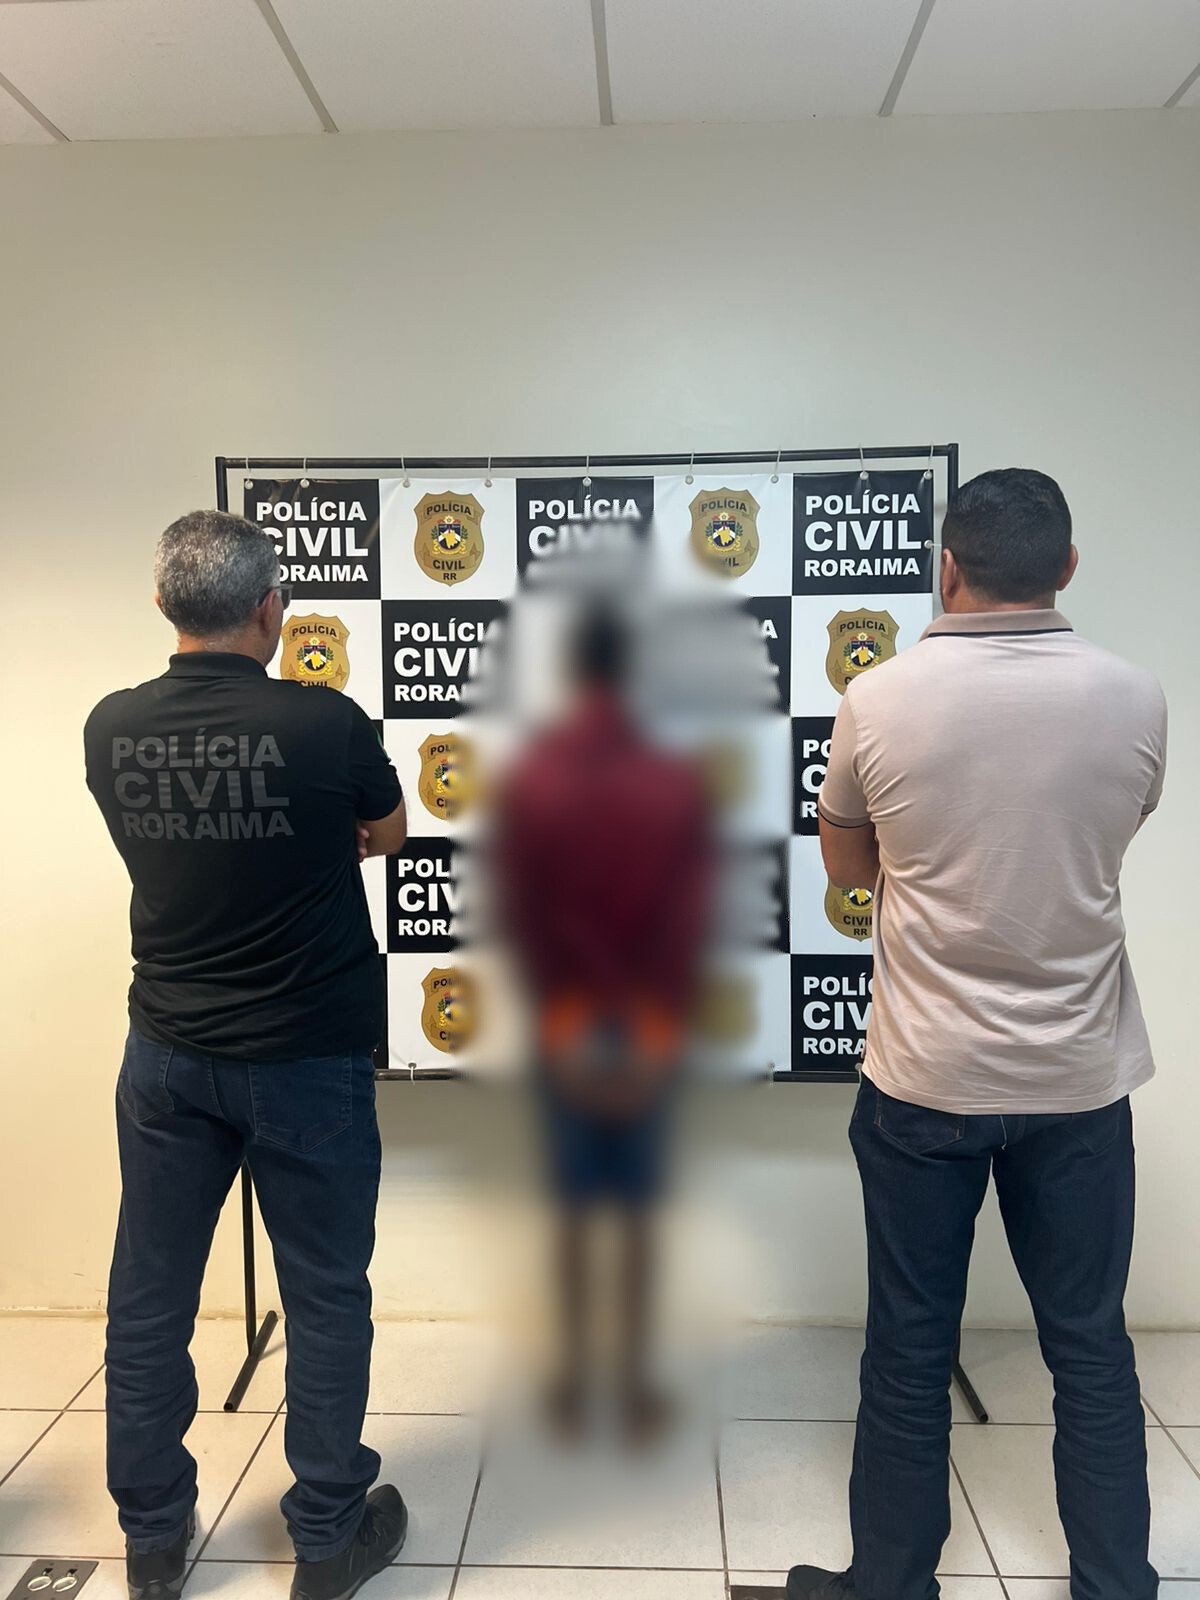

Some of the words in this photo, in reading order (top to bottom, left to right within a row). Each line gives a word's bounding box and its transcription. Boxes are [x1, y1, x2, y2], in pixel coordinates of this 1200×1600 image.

[256, 497, 367, 521] POLÍCIA
[426, 502, 472, 515] POLÍCIA
[529, 494, 641, 520] POLÍCIA
[701, 499, 747, 513] POLÍCIA
[806, 490, 920, 515] POLÍCIA
[805, 520, 921, 551] CIVIL
[280, 564, 368, 582] ORAIMA
[432, 559, 466, 571] CIVIL
[804, 558, 920, 577] RORAIMA
[443, 572, 457, 581] RR
[292, 623, 337, 638] POLÍCIA
[839, 618, 886, 632] POLÍCIA
[394, 647, 478, 677] CIVI
[394, 684, 461, 701] RORA
[111, 728, 286, 769] POLÍCIA
[114, 770, 290, 809] CIVIL
[121, 811, 295, 840] RORAIMA
[853, 928, 868, 936] RR
[803, 973, 873, 996] POLÍ
[803, 1001, 872, 1030] CIV
[803, 1037, 866, 1055] RORA
